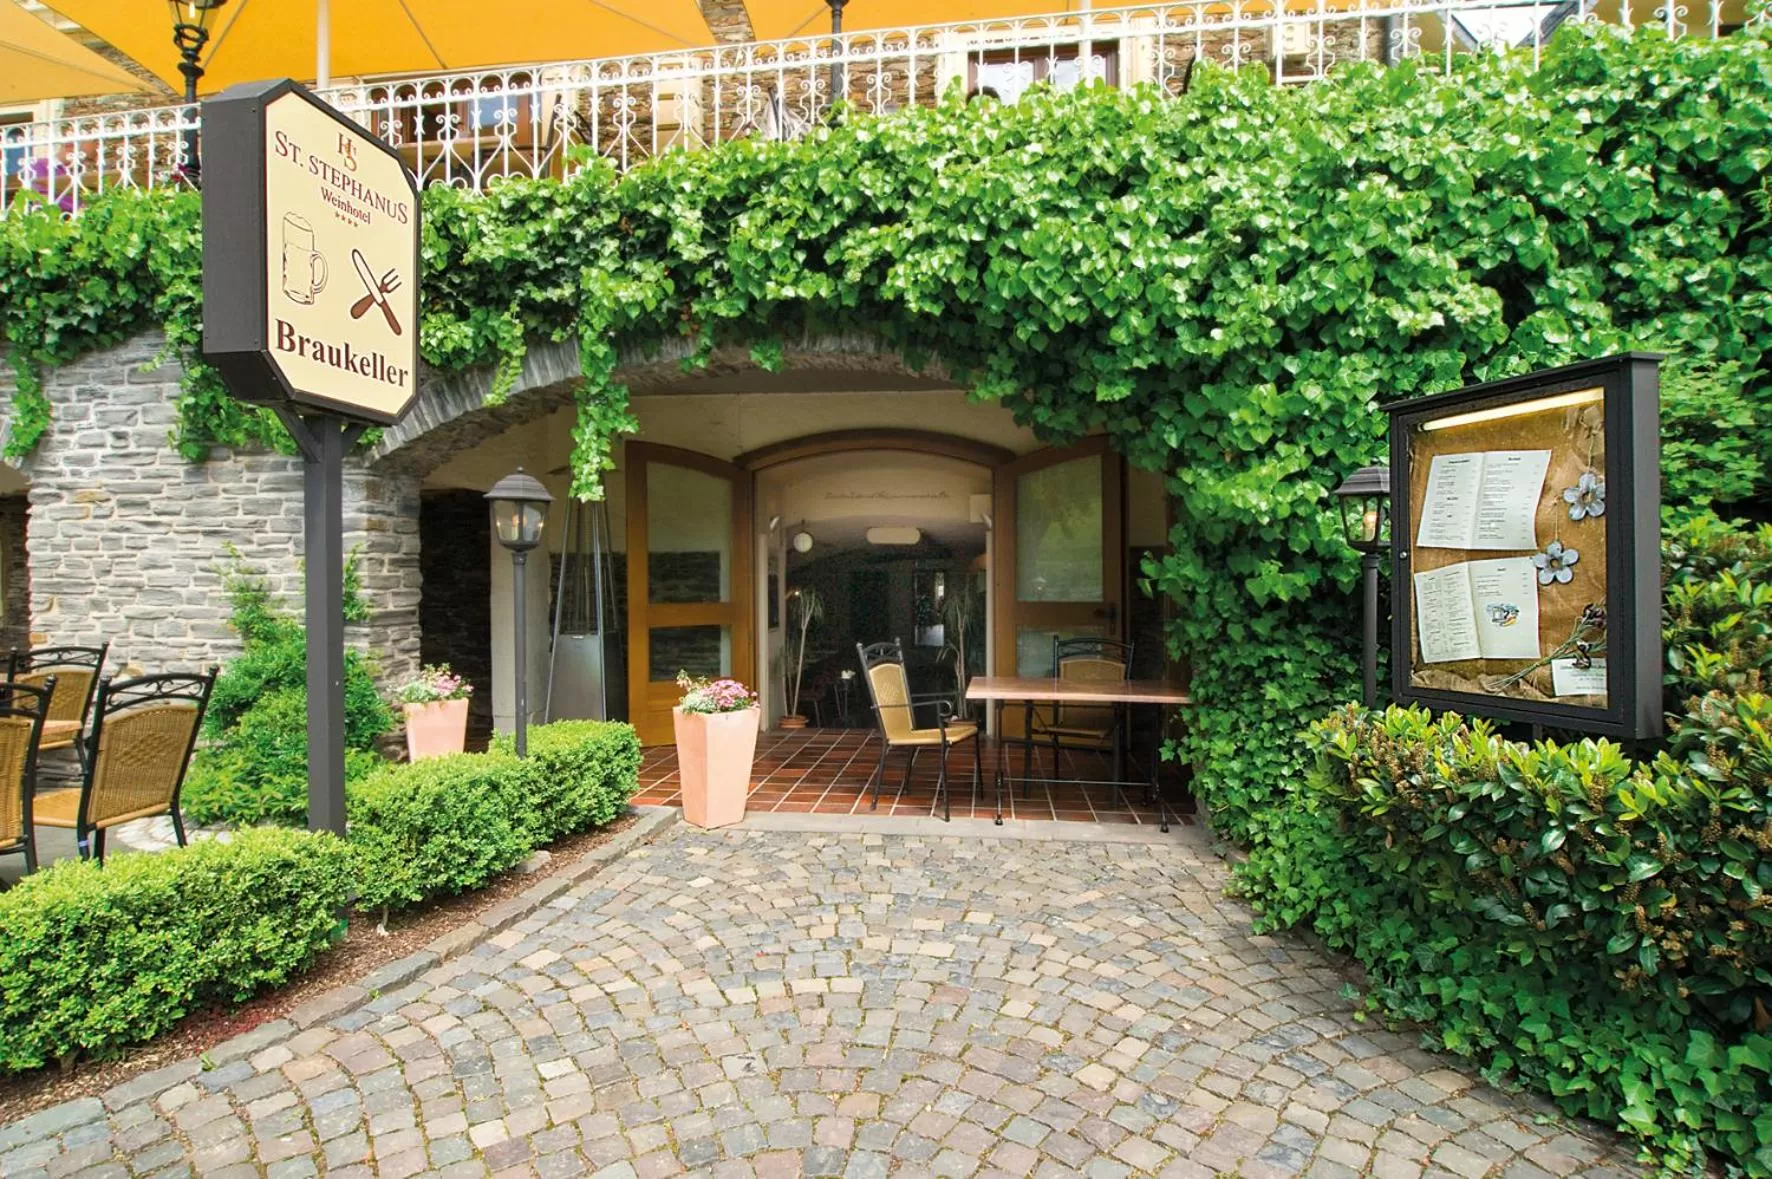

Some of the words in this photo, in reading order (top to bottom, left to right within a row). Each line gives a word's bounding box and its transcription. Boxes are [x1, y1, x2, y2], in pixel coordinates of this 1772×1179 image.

[275, 130, 304, 167] ST.
[309, 155, 408, 224] STEPHANUS
[320, 186, 371, 224] Weinhotel
[276, 319, 409, 387] Braukeller
